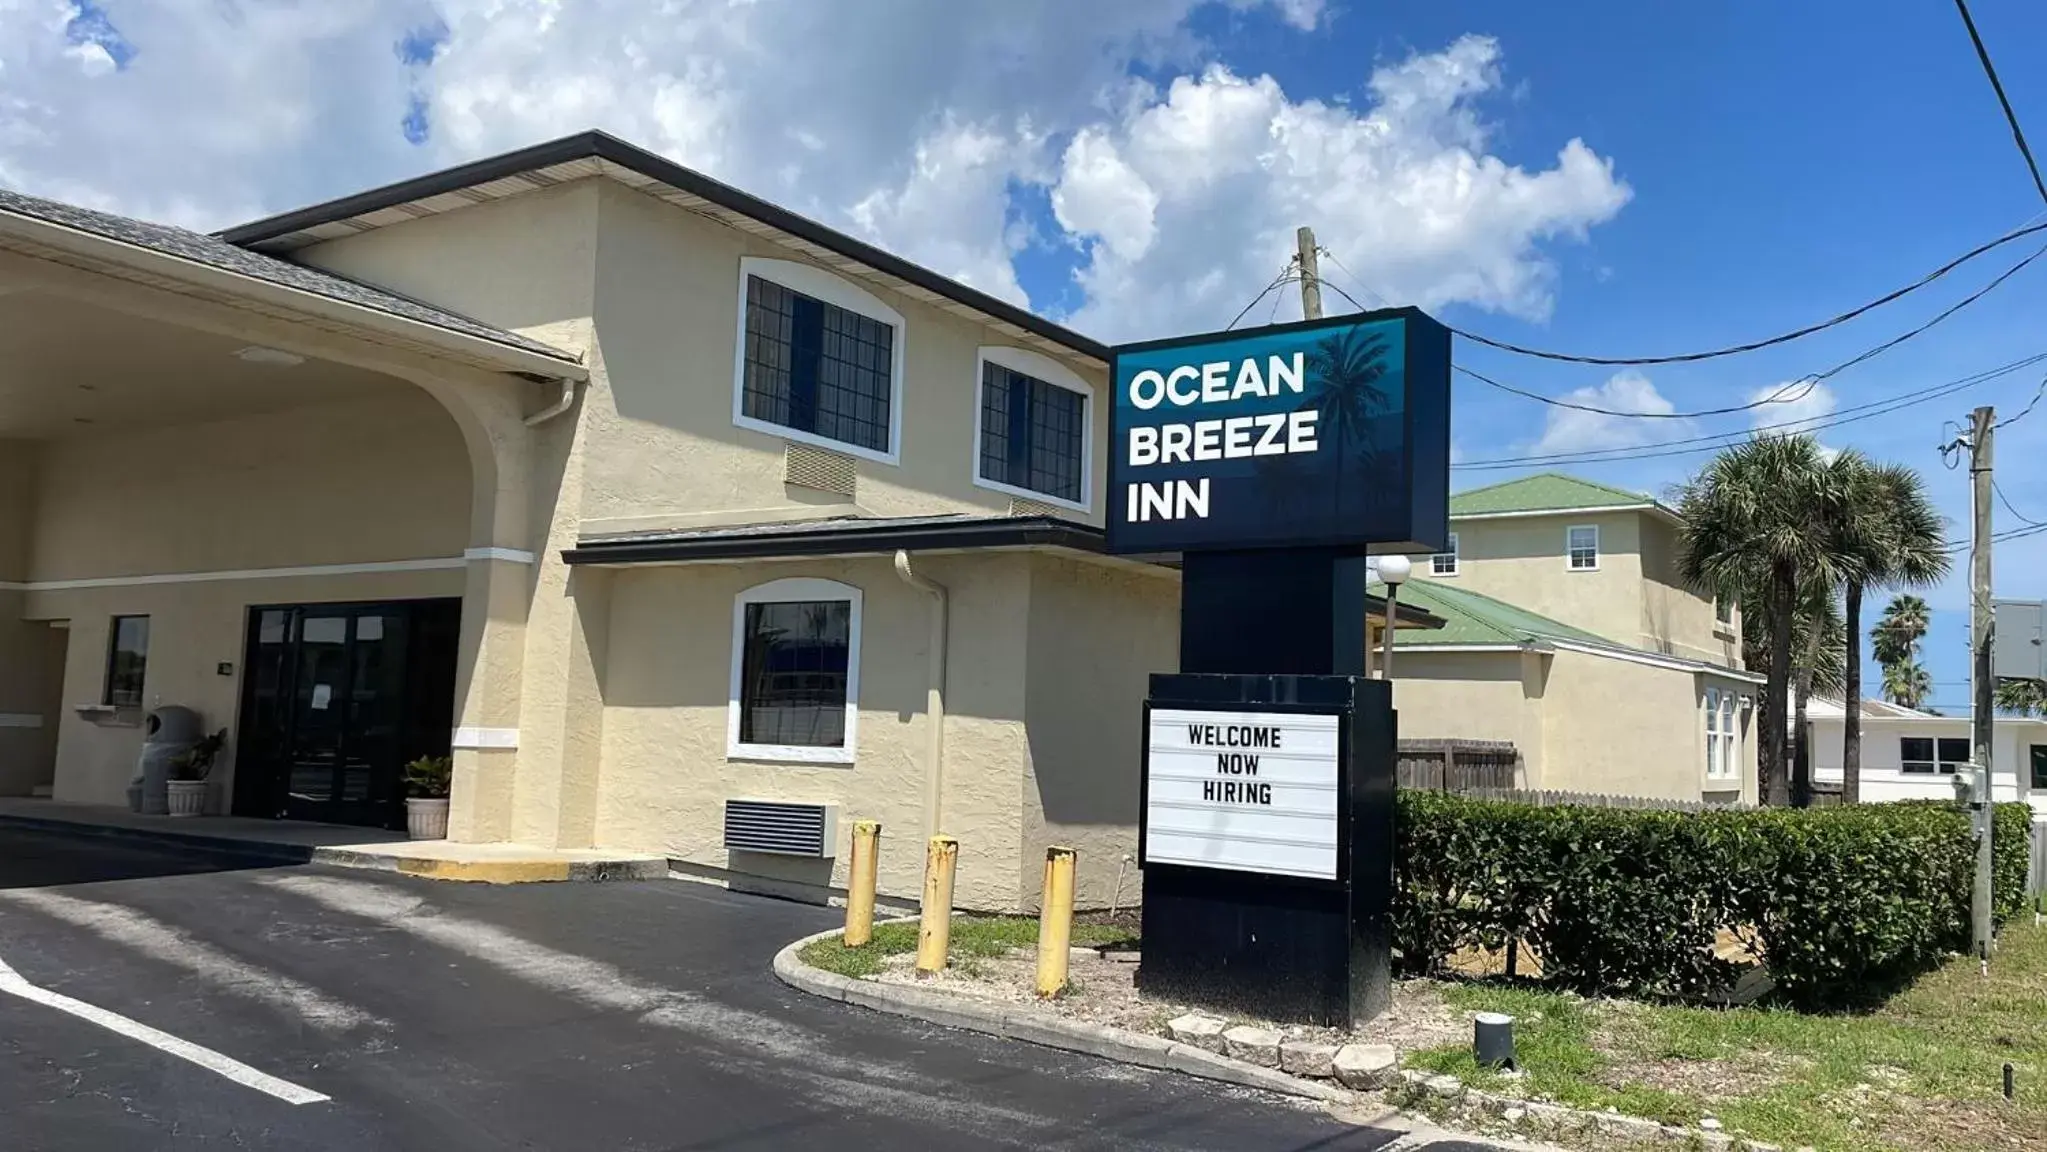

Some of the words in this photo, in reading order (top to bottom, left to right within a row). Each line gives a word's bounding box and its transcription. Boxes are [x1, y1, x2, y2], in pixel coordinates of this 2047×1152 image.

[1130, 353, 1303, 409] OCEAN
[1130, 411, 1318, 465] BREEZE
[1128, 479, 1209, 521] INN
[1189, 725, 1280, 747] WELCOME
[1218, 754, 1259, 775] NOW
[1204, 781, 1270, 804] HIRING
